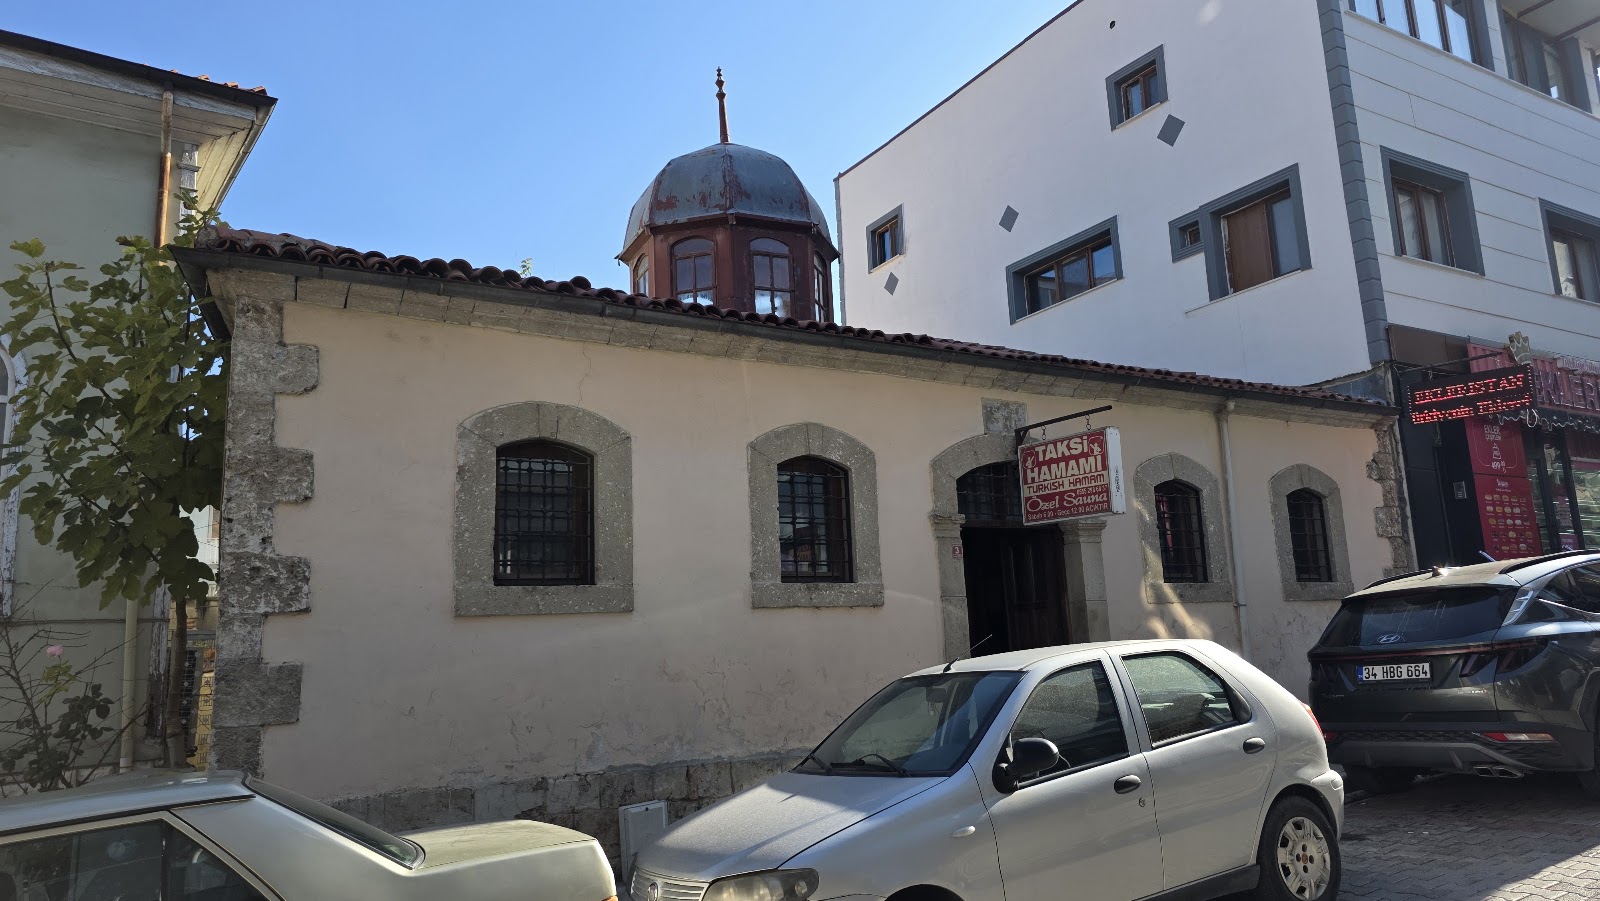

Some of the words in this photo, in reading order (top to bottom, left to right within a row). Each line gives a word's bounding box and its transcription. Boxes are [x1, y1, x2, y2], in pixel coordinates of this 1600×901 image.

[1027, 455, 1102, 483] HAMAMI
[1027, 481, 1065, 494] TURKISH
[1069, 474, 1105, 487] HAMAM
[1027, 496, 1059, 512] Özel
[1063, 493, 1108, 506] Sauna
[1364, 667, 1377, 679] 34
[1382, 666, 1402, 678] HBG
[1406, 665, 1427, 678] 664
